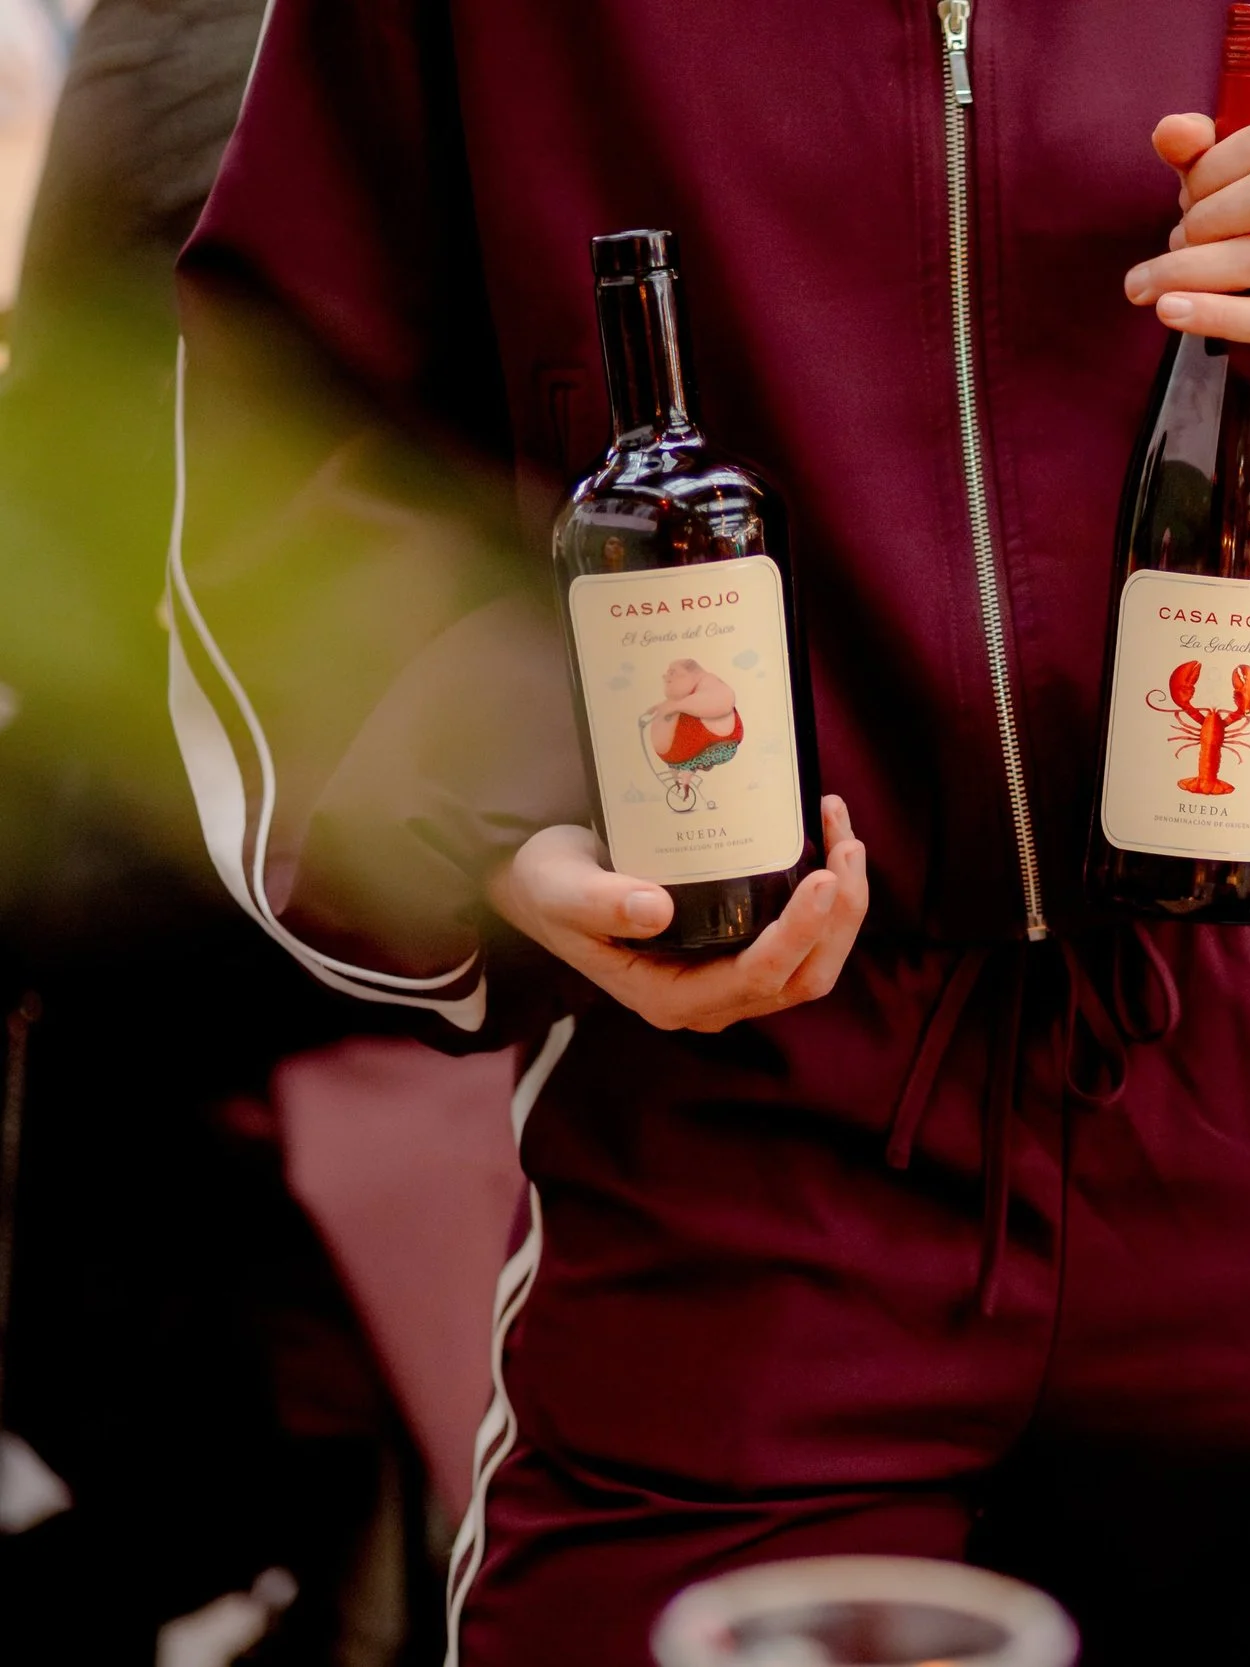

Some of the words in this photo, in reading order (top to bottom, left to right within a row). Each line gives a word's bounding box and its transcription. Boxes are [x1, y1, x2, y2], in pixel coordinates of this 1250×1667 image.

[610, 601, 671, 618] CASA
[681, 591, 740, 611] ROJO
[1159, 607, 1218, 625] CASA
[622, 631, 636, 647] El
[640, 630, 678, 647] Gordo
[681, 625, 702, 640] del
[1179, 634, 1201, 649] La
[1178, 803, 1229, 817] RUEDA
[676, 827, 727, 841] RUEDA
